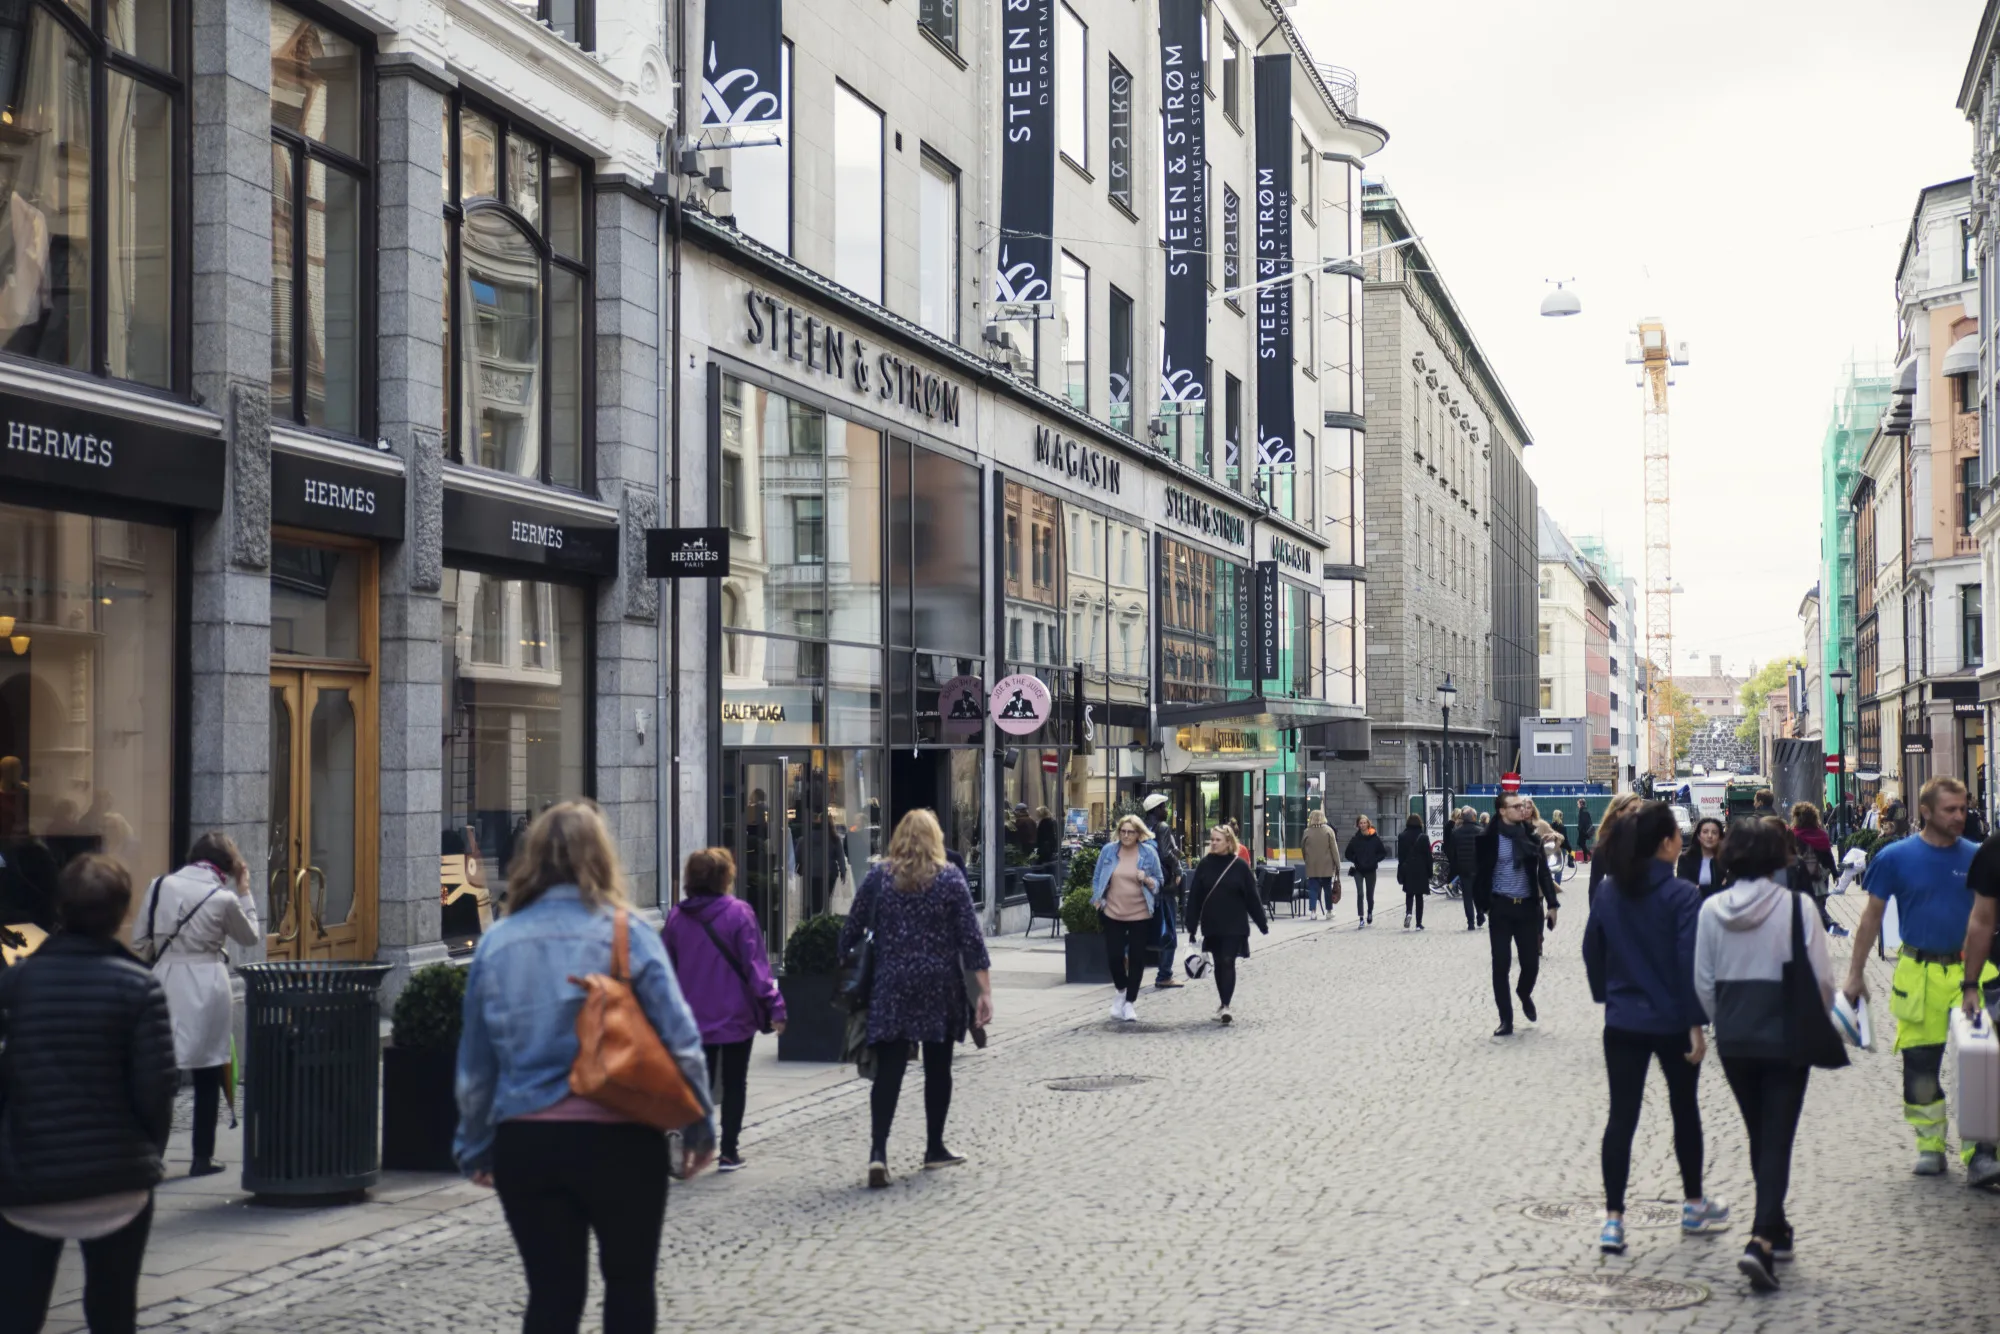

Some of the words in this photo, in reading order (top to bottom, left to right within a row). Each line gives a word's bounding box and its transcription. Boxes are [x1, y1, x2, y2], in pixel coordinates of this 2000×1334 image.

[1039, 0, 1049, 105] DEPARTM
[1009, 28, 1031, 142] STEEN
[1165, 45, 1186, 145] STRØM
[1190, 71, 1201, 125] STORE
[1168, 155, 1187, 174] &
[1191, 135, 1204, 247] DEPARTMENT
[1169, 185, 1188, 275] STEEN
[1259, 168, 1275, 250] STRØM
[1279, 190, 1288, 235] STORE
[1260, 259, 1275, 275] &
[1260, 284, 1276, 358] STEEN
[748, 290, 845, 379] STEEN
[853, 339, 872, 393] &
[879, 352, 960, 428] STRØM
[7, 420, 113, 467] HERMÈS
[1035, 424, 1121, 495] MAGASIN
[304, 479, 375, 514] HERMÈS
[1166, 485, 1201, 529] STEEN
[1203, 502, 1211, 534] &
[1212, 507, 1245, 546] STRØM
[511, 520, 563, 549] HERMÈS
[671, 551, 719, 562] HERMÈS
[1272, 534, 1311, 574] MAGASIN
[1264, 566, 1273, 674] VINMONOPOLET
[723, 703, 787, 721] BALENCIAGA
[994, 686, 1005, 699] JOE
[1012, 677, 1025, 686] THE
[1026, 681, 1044, 699] JUICE
